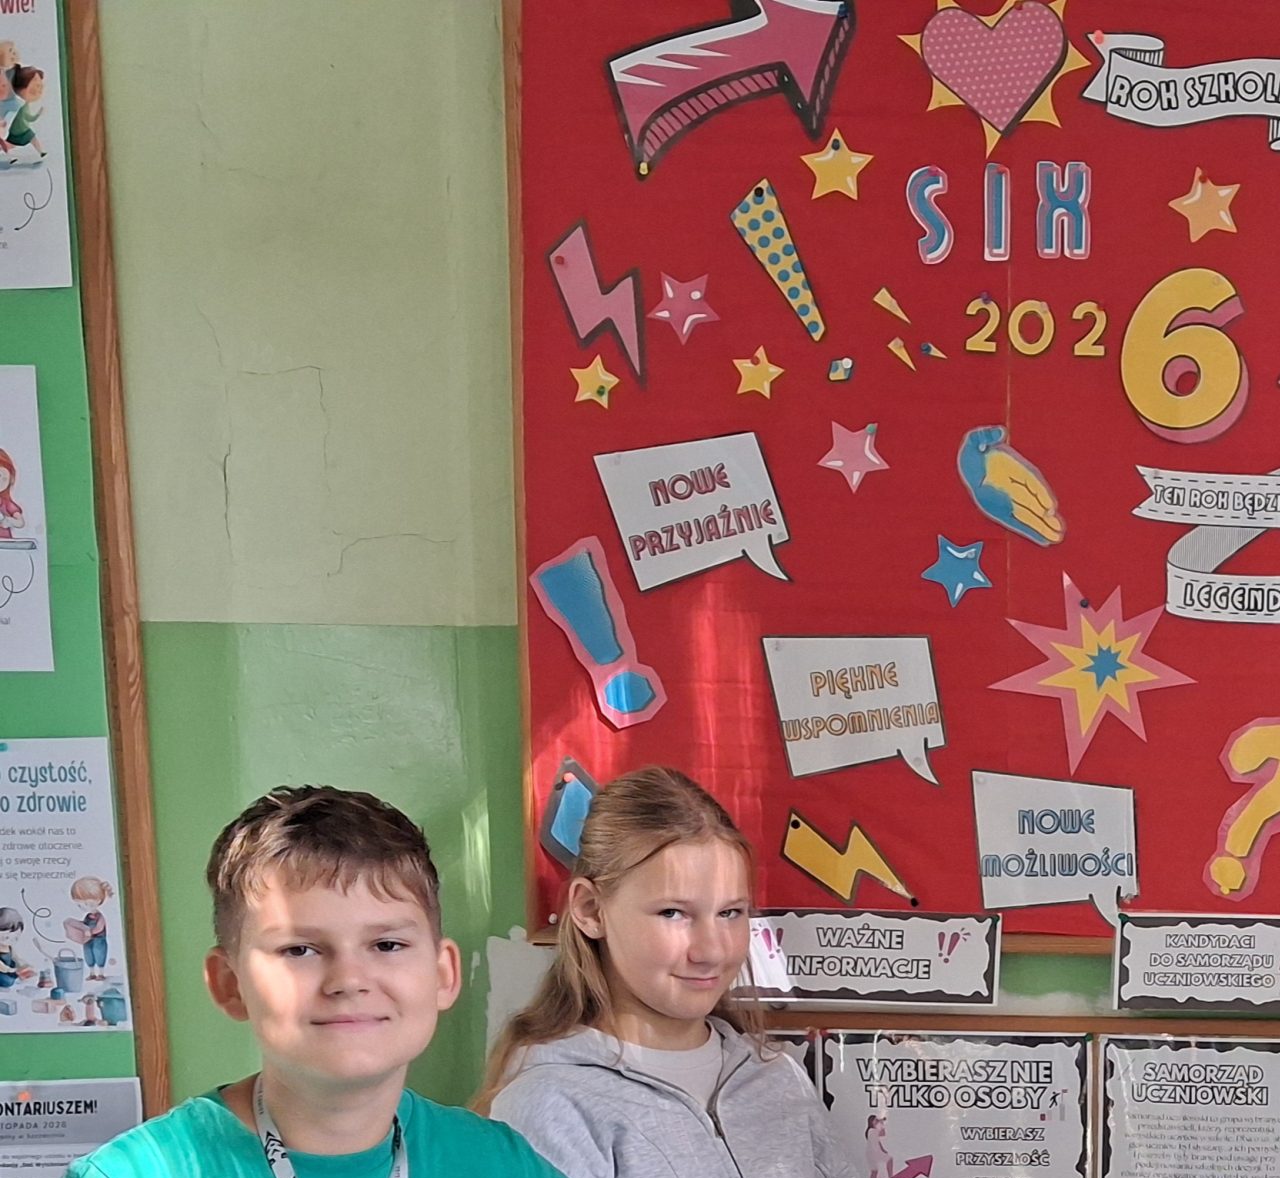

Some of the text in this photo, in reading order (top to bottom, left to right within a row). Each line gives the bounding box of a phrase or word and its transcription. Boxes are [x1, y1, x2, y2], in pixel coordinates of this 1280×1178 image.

[905, 161, 1092, 264] SIX
[649, 462, 731, 507] NOWE
[1154, 484, 1186, 506] TEN
[628, 499, 777, 560] PRZYJAŹNIE
[810, 662, 899, 699] PIĘKNE
[781, 701, 940, 742] WSPOMNIENIA
[8, 760, 92, 788] czystość,
[16, 790, 87, 812] zdrowie
[1018, 809, 1095, 834] NOWE
[981, 847, 1133, 877] MOŻLIWOŚCI
[817, 923, 904, 950] WAŻNE
[1165, 934, 1256, 949] KANDYDACI
[787, 956, 931, 979] INFORMACJE
[1150, 954, 1274, 970] DO SAMORZĄDU
[1144, 972, 1275, 987] UCZNIOWSKIEGO
[856, 1058, 1052, 1084] WYBIERASZ NIE
[1143, 1062, 1264, 1087] SAMORZĄD
[865, 1085, 1047, 1109] TYLKO OSOBY
[1132, 1083, 1269, 1105] UCZNIOWSKI
[961, 1127, 1045, 1141] WYBIERASZ
[956, 1149, 1050, 1166] PRZYSZŁOŚĆ
